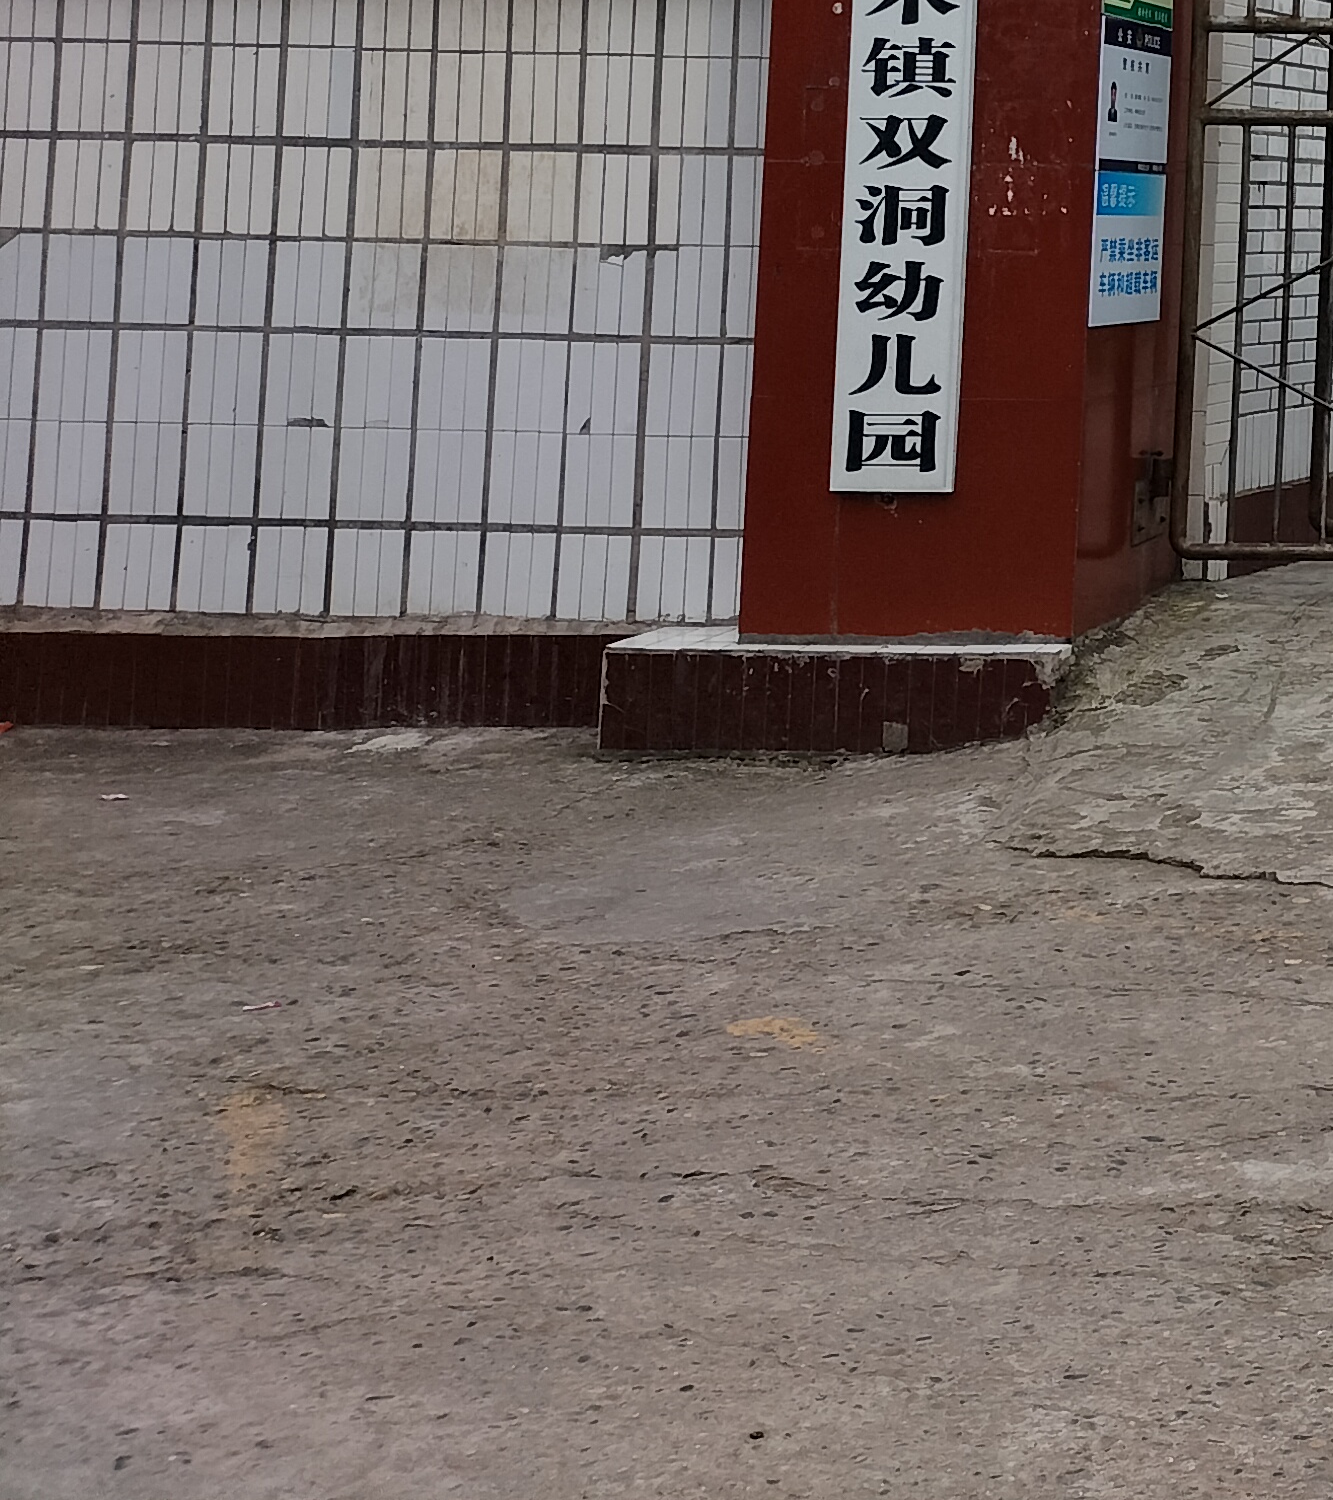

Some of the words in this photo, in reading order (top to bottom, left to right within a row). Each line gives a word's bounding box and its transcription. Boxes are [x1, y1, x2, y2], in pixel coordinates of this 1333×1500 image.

[1101, 183, 1136, 208] 温馨提示
[1100, 237, 1159, 263] 严禁乘坐非客运
[1098, 270, 1158, 297] 车辆和超载车辆
